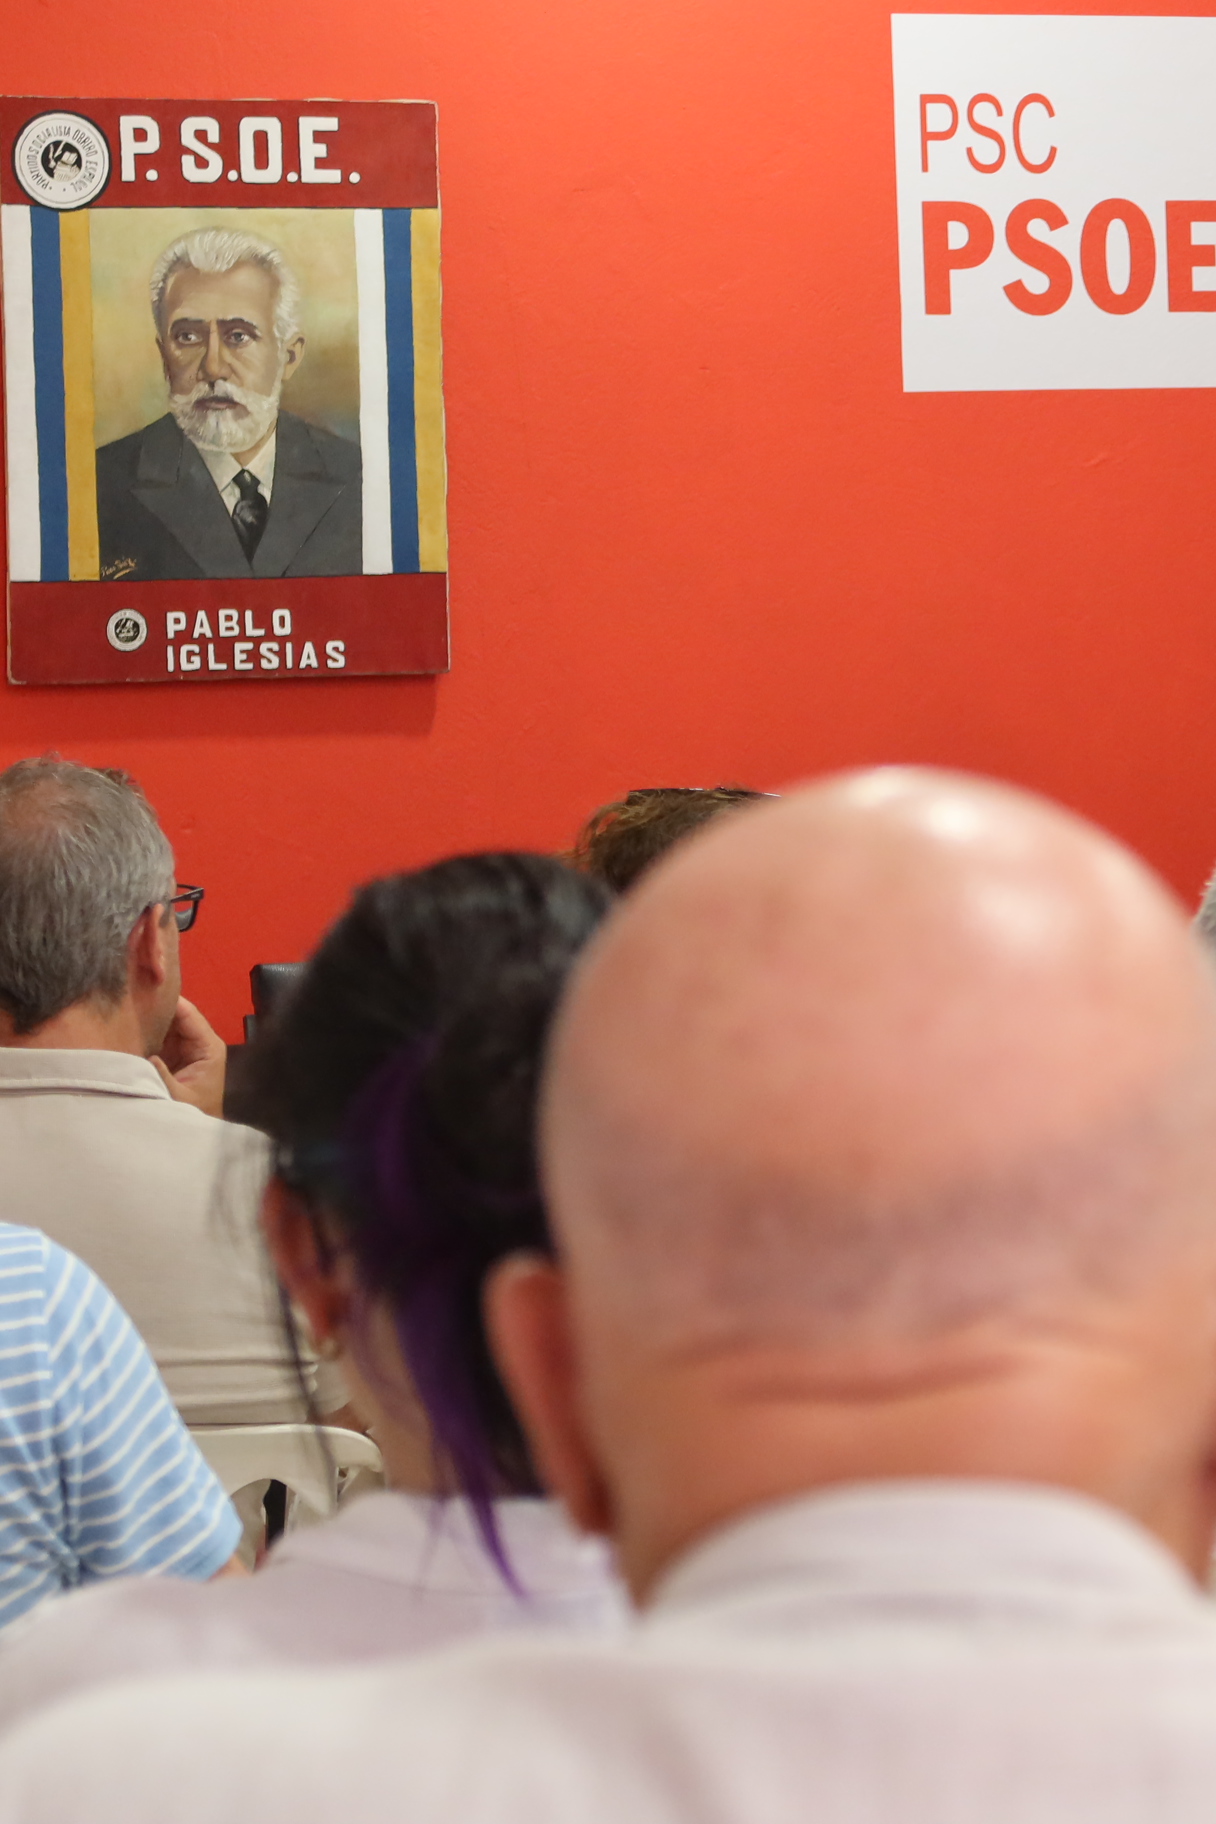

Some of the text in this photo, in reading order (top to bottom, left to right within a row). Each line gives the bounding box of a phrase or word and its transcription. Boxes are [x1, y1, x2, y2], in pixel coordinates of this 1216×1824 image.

[919, 92, 1058, 174] PSC
[166, 608, 292, 640] PABLO
[166, 640, 346, 673] IGLESIAS
